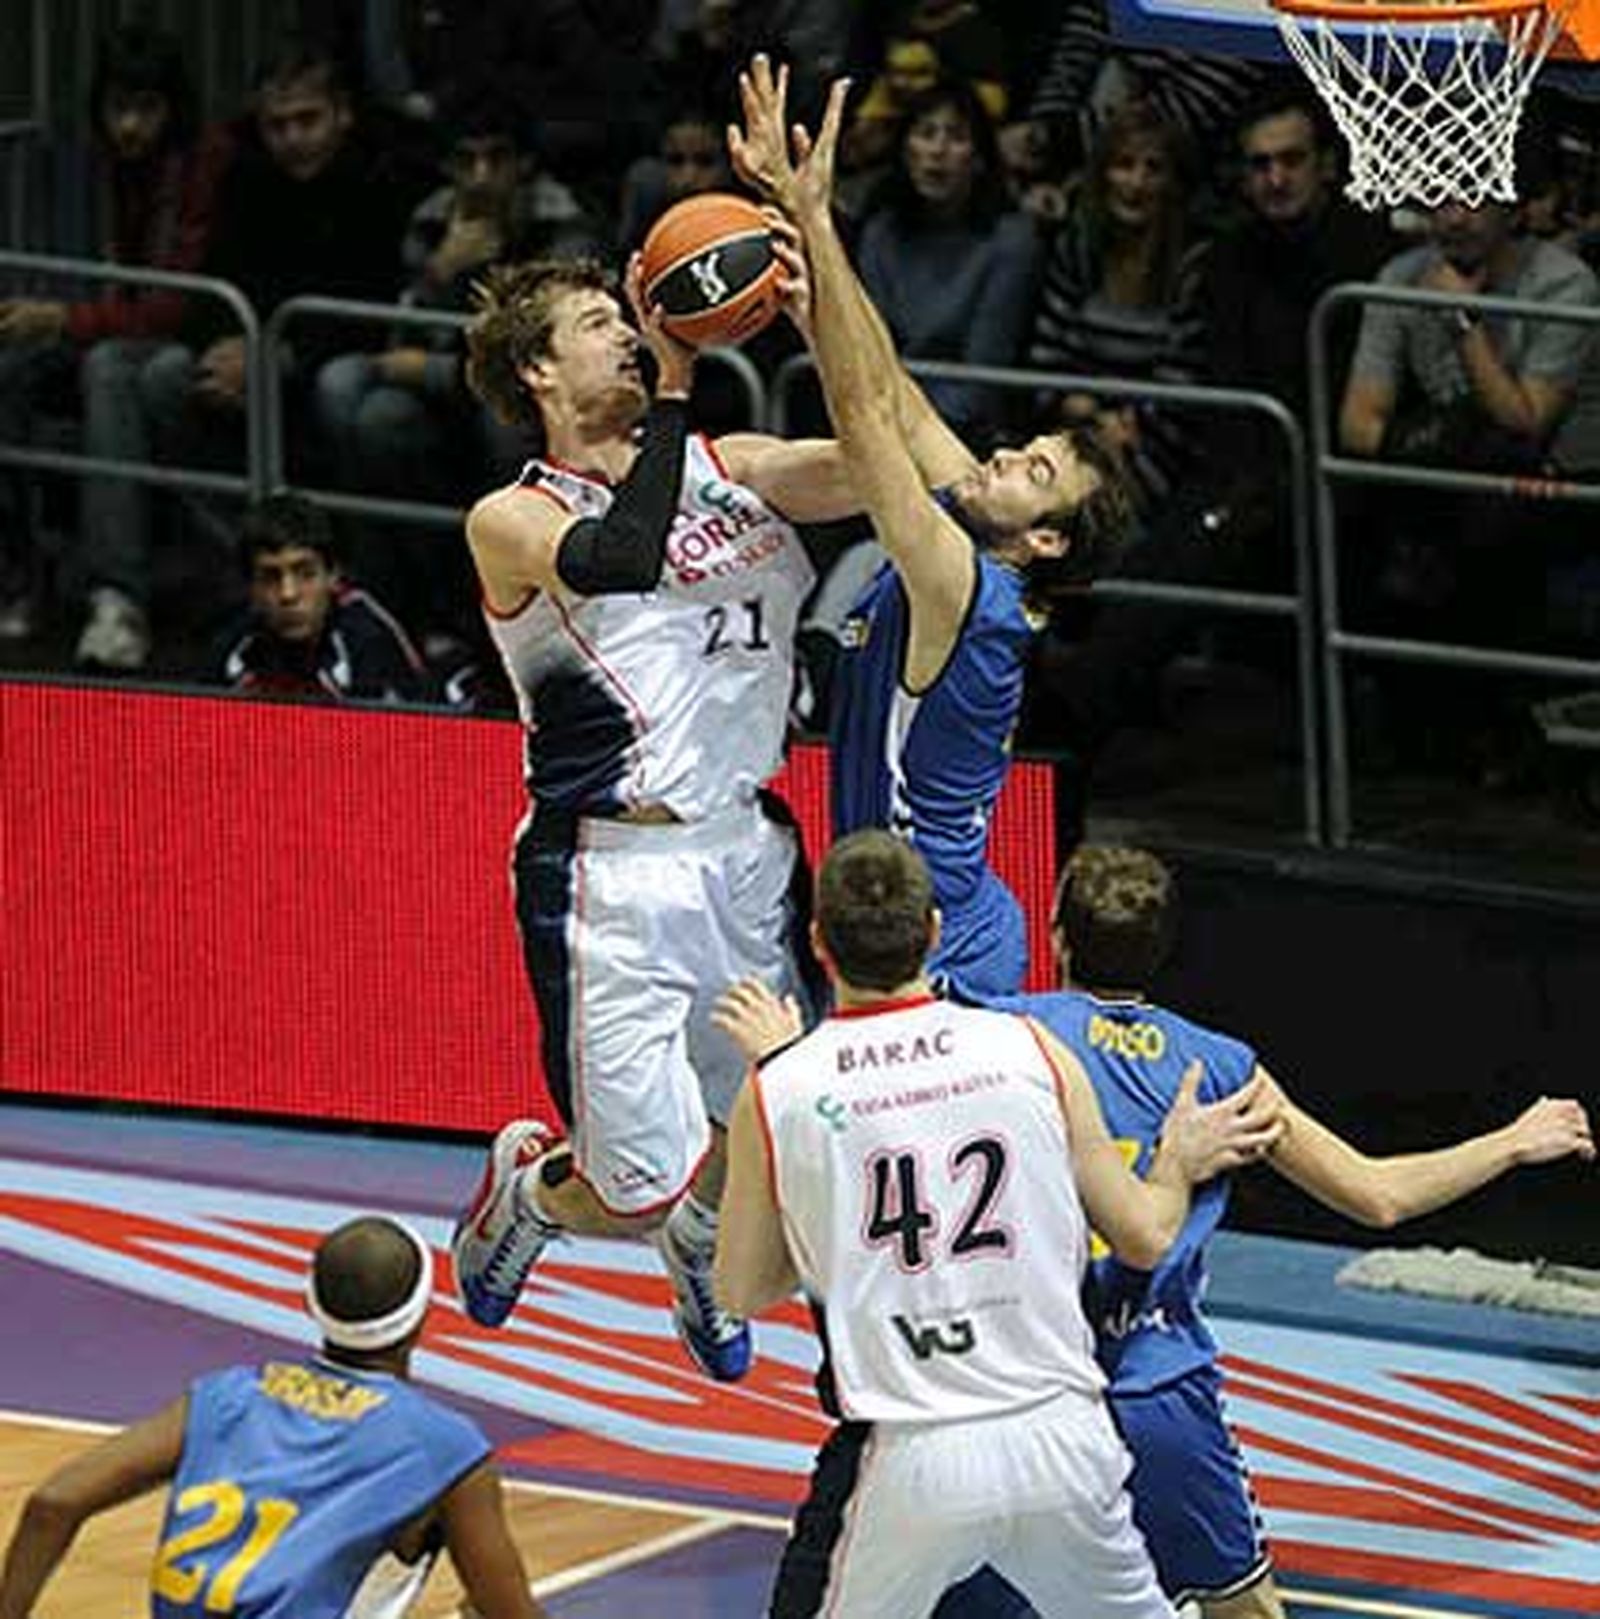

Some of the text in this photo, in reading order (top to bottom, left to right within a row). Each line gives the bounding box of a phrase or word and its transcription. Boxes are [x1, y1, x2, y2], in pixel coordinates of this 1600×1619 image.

[702, 598, 769, 655] 21
[836, 1029, 954, 1073] BARAC
[864, 1134, 1014, 1271] 42
[152, 1479, 299, 1613] 21
